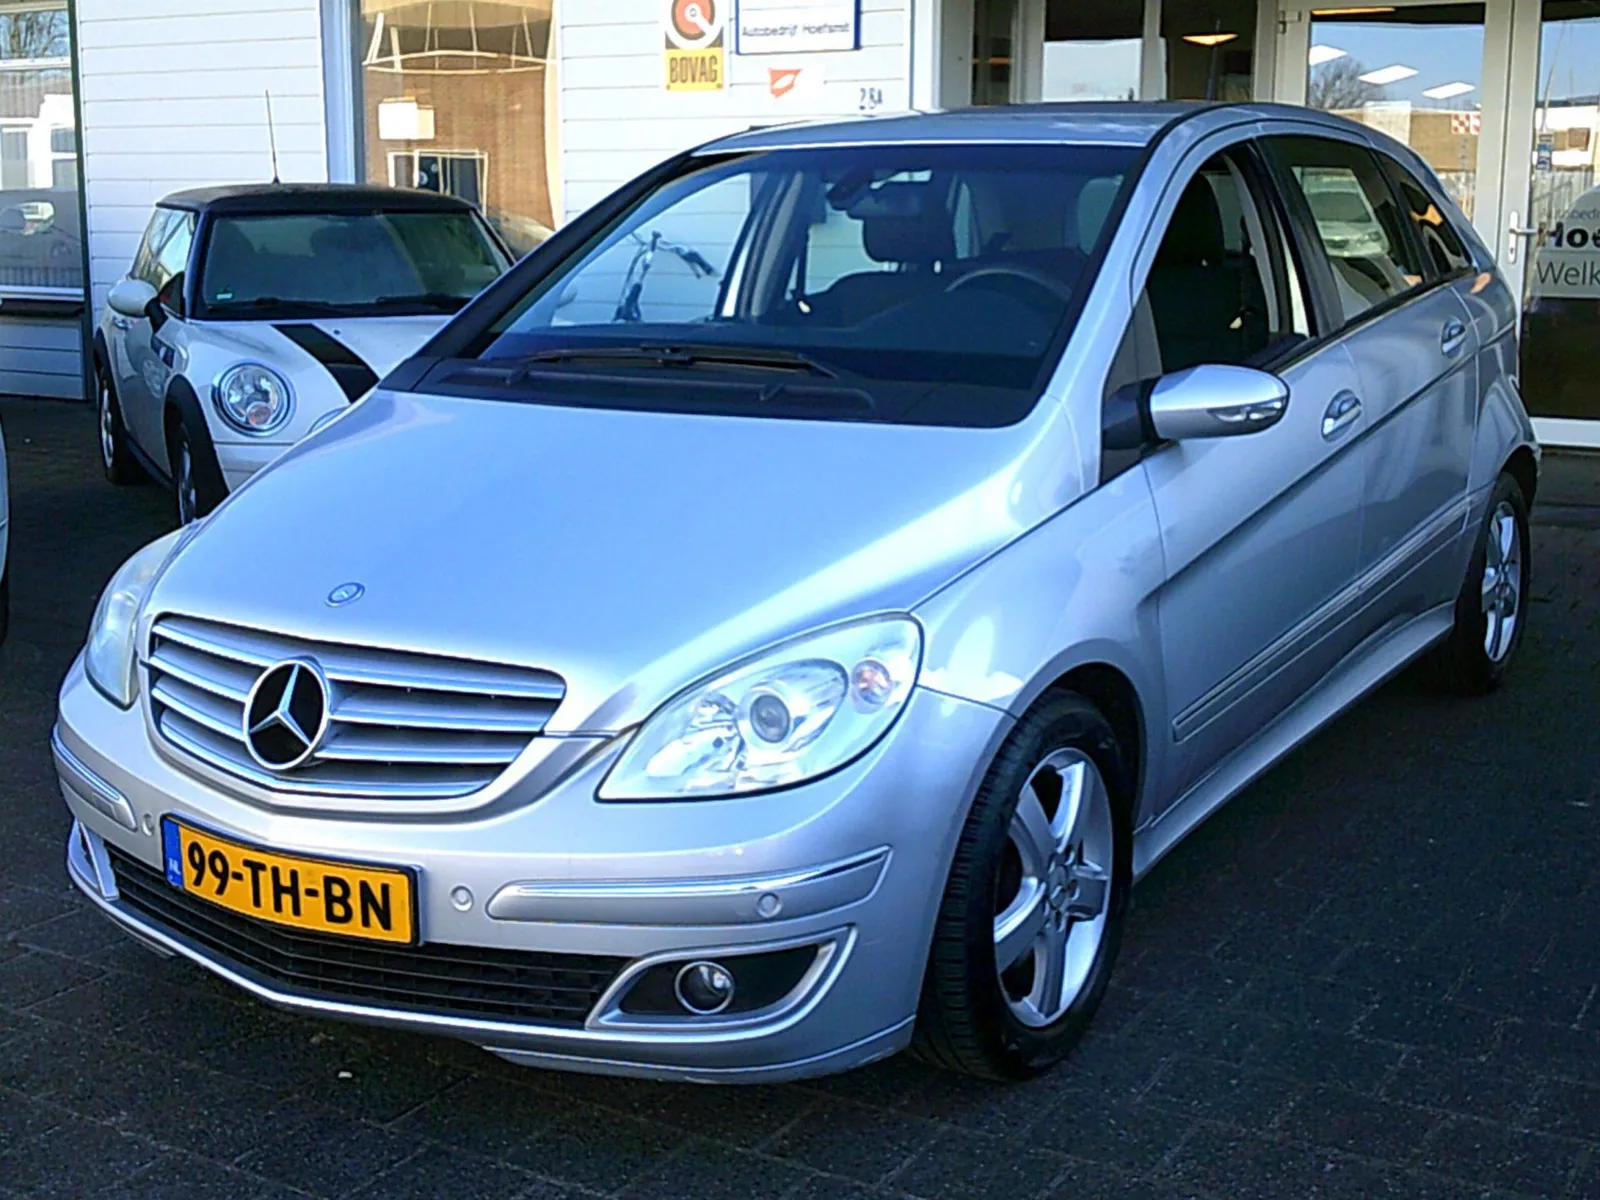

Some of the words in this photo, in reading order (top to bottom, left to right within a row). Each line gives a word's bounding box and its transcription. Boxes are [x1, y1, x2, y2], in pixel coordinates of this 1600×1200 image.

[669, 55, 718, 84] BOVAG
[1536, 260, 1600, 286] Welk
[187, 841, 392, 931] 99-TH-BN
